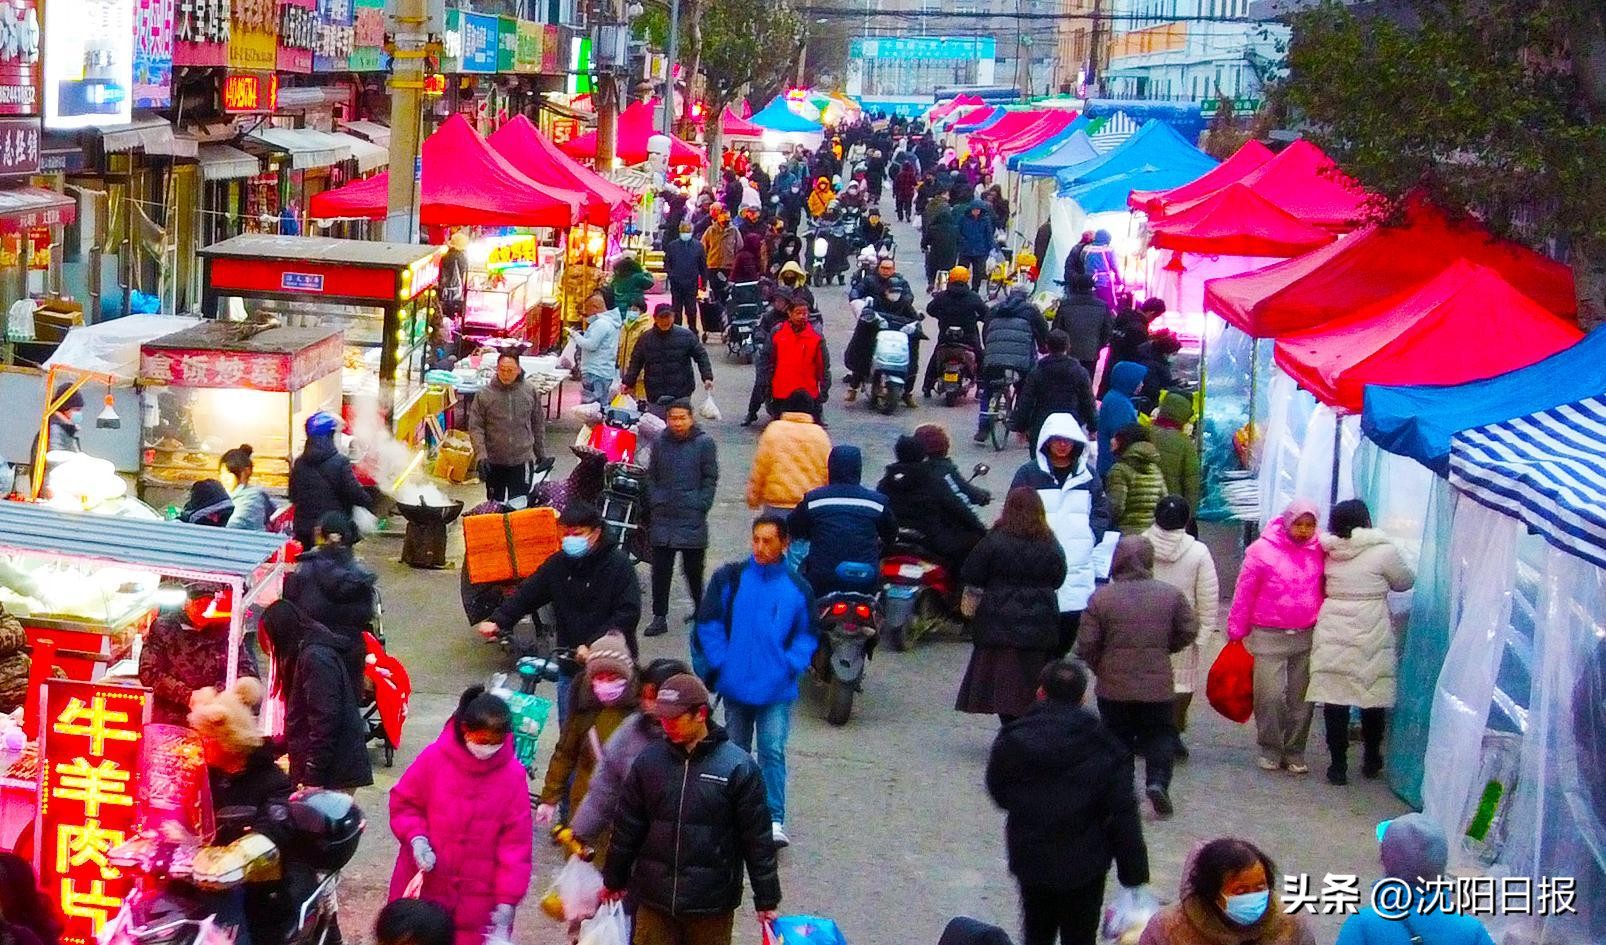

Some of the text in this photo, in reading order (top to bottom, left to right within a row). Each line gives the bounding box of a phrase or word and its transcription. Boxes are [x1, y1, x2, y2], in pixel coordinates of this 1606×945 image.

[0, 129, 38, 167] 总经销
[53, 697, 142, 937] 牛羊肉片
